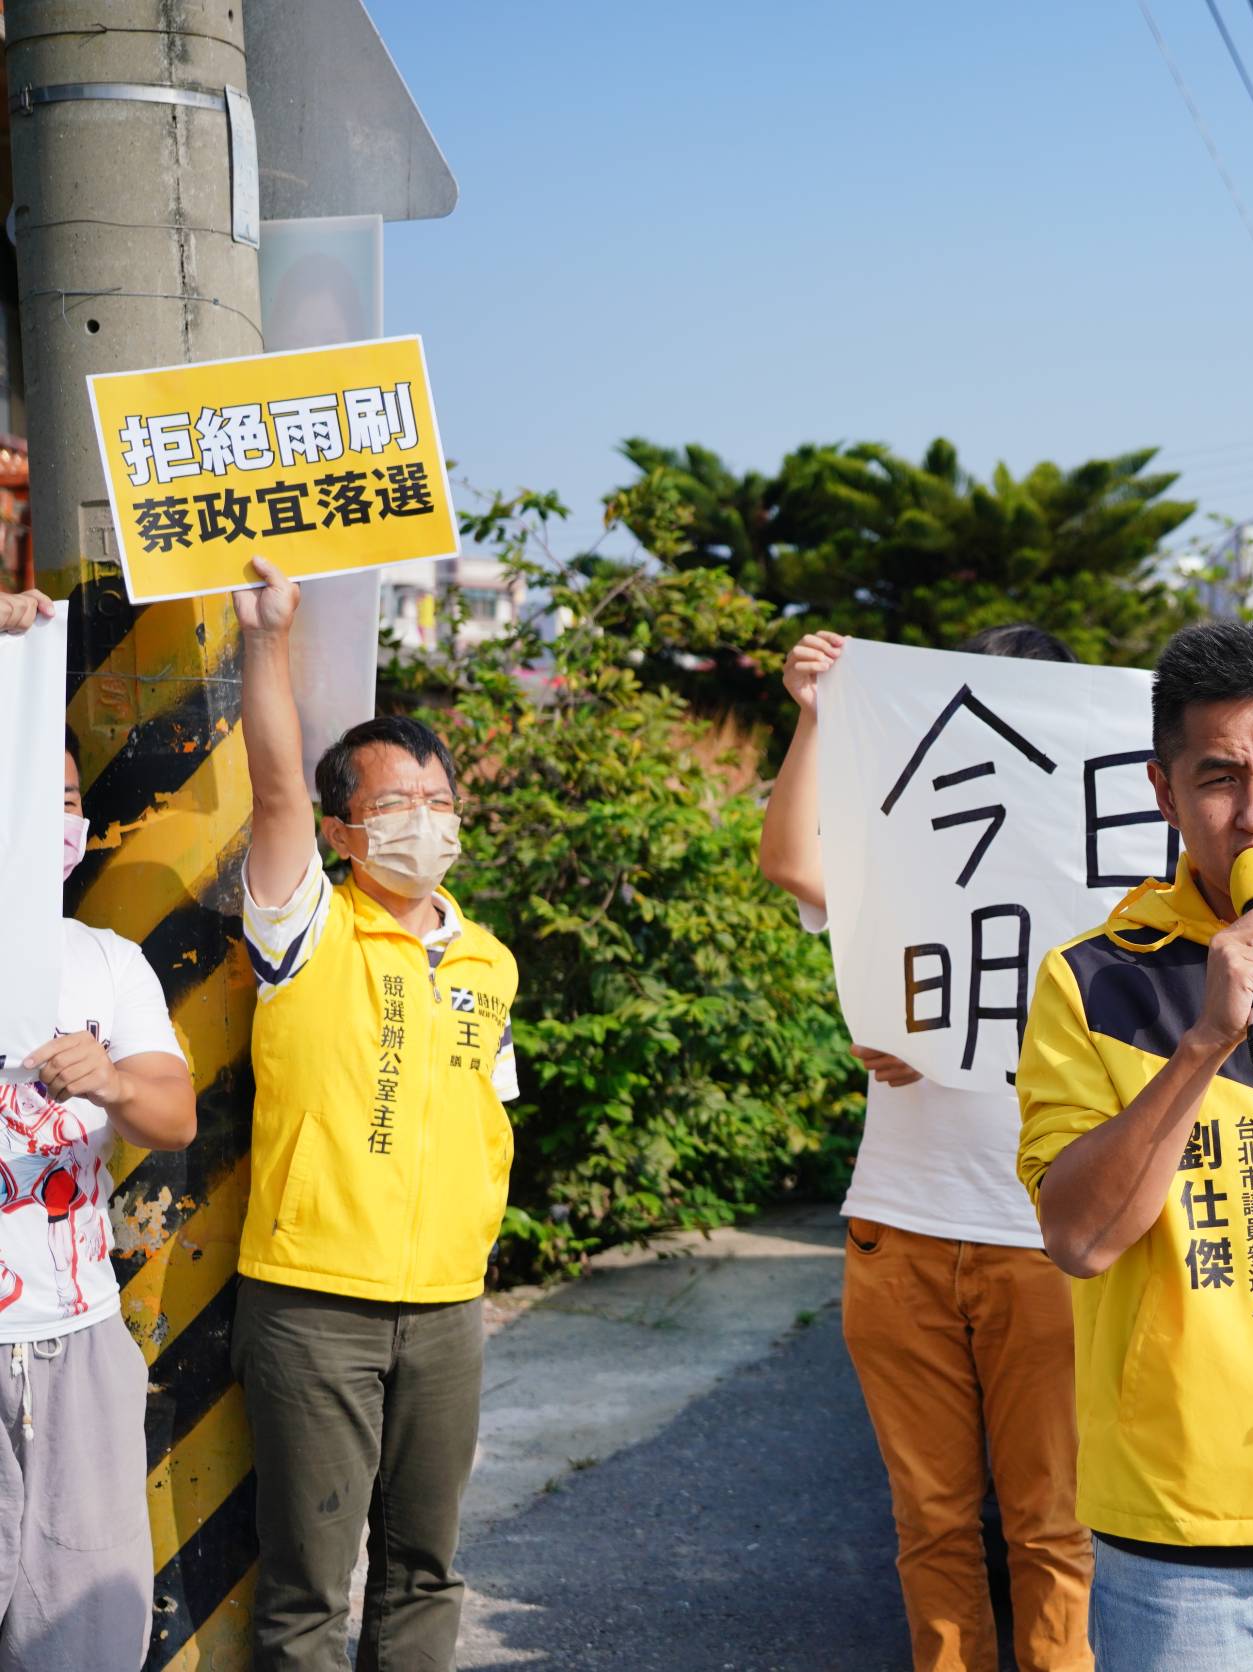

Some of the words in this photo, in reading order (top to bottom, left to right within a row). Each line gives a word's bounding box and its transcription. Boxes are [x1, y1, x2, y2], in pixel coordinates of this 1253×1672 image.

[119, 381, 420, 487] 拒絕雨刷
[132, 462, 435, 554] 蔡政宜落選
[367, 974, 405, 1155] 競選辦公室主任
[1176, 1118, 1235, 1290] 劉仕傑
